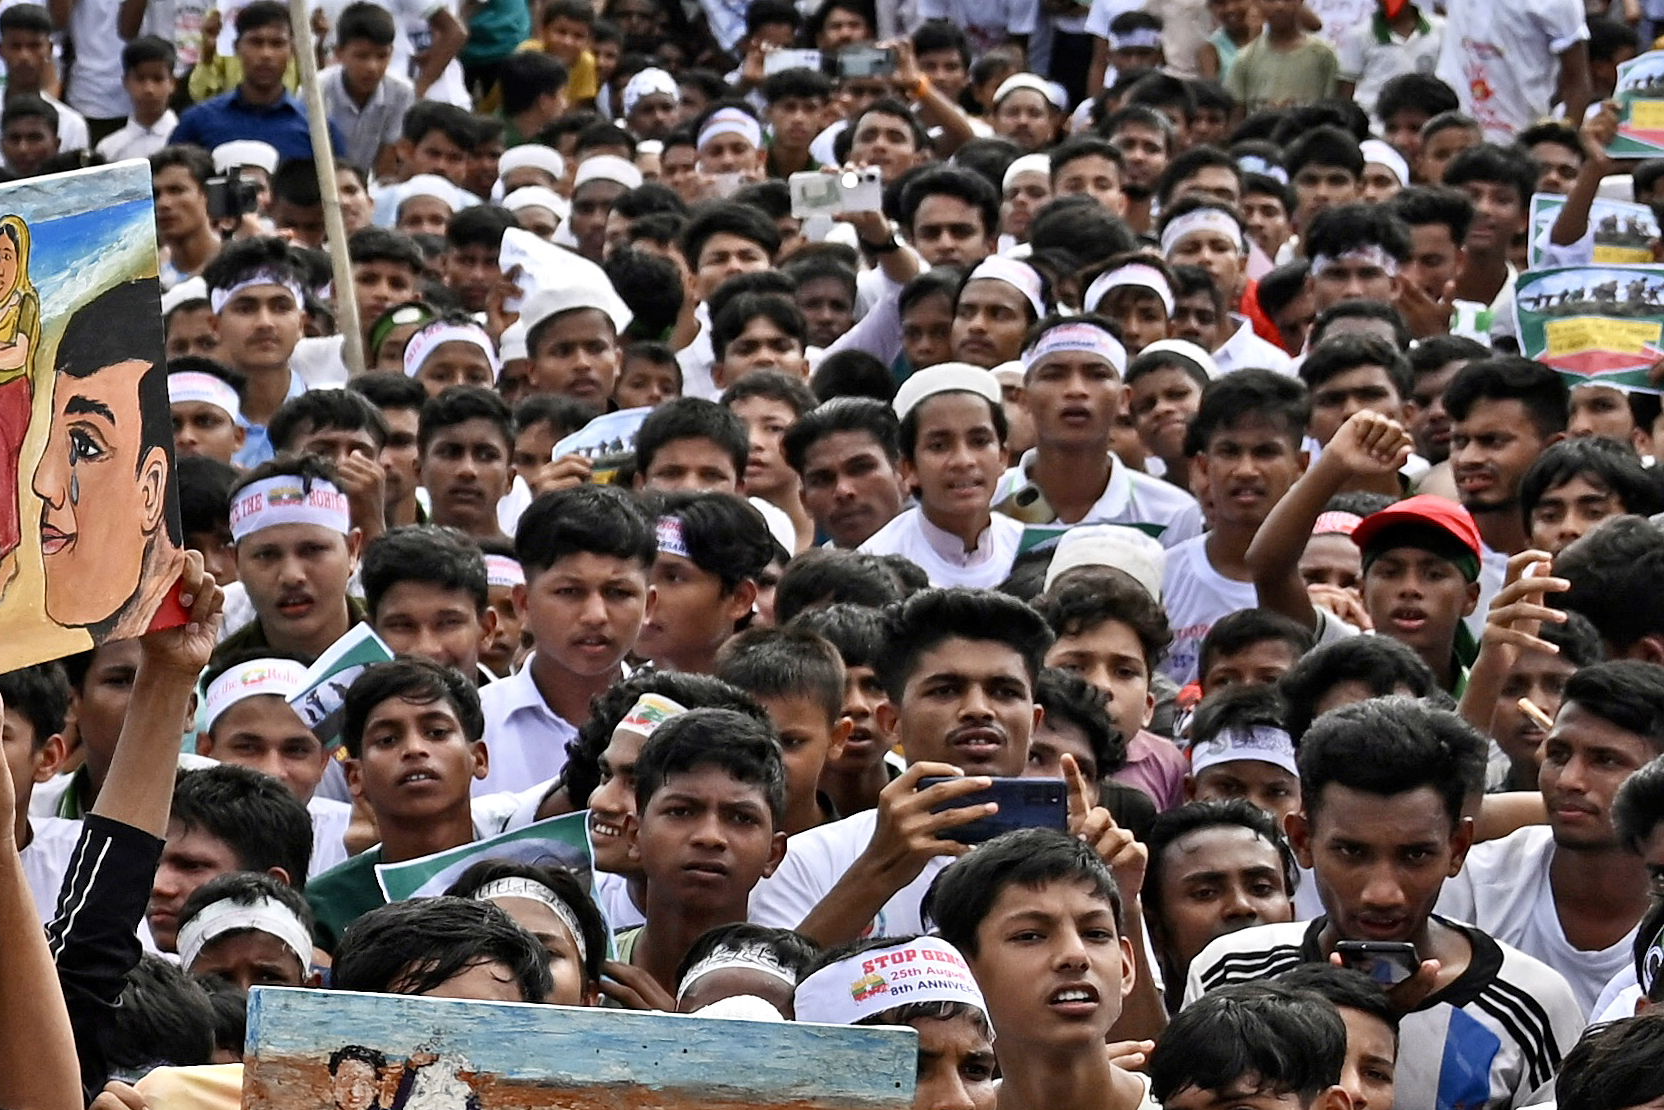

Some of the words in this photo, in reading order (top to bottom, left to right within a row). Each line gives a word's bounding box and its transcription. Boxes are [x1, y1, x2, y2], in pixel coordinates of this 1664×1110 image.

[862, 949, 917, 975] STOP
[890, 967, 922, 981] 25th
[890, 983, 914, 997] 8th
